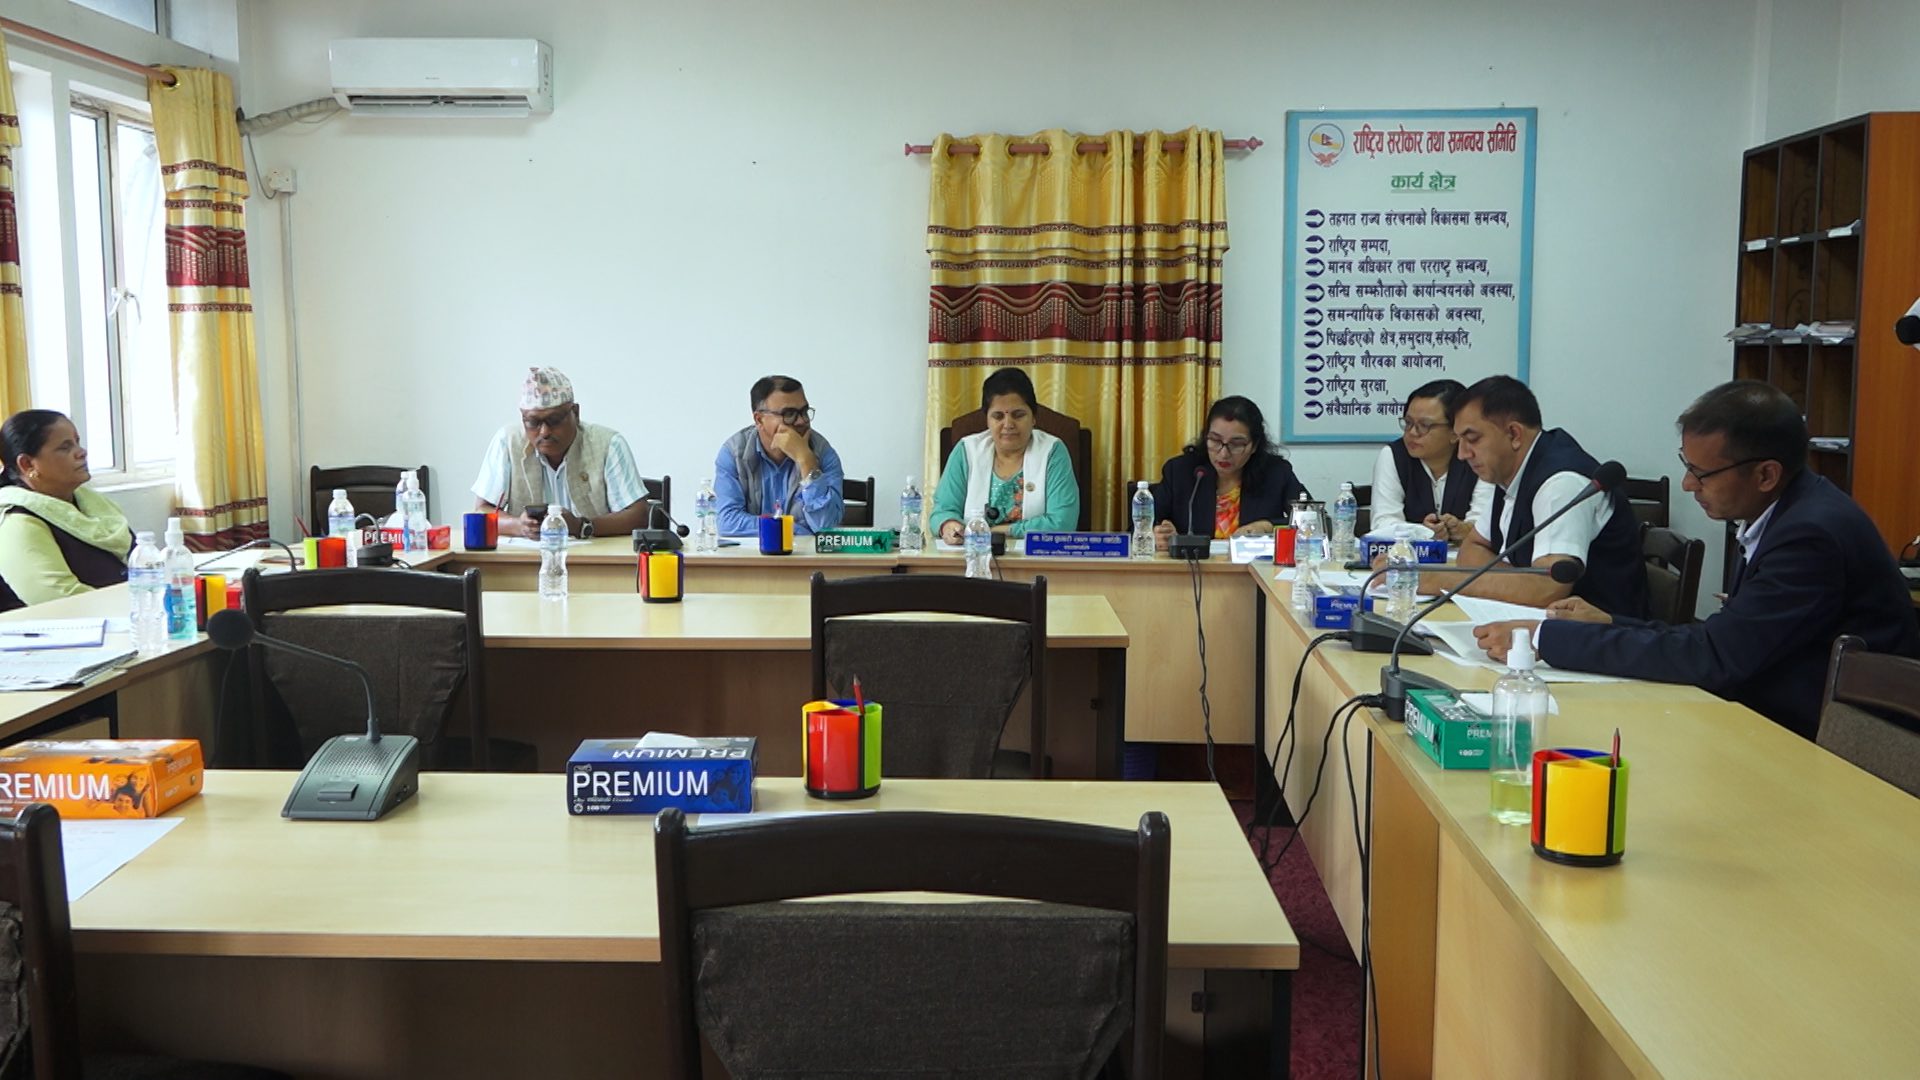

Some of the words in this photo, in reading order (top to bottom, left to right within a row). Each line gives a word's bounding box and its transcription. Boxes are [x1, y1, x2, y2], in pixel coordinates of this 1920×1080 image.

[1353, 123, 1384, 158] राष्ट्रिय
[1387, 124, 1424, 154] सरोकार
[1426, 130, 1445, 153] तथा
[1448, 130, 1484, 153] समन्वय
[1487, 121, 1518, 153] समिति
[1391, 171, 1424, 189] कार्य
[1428, 170, 1457, 190] क्षेत्र
[1329, 213, 1356, 226] तहगत
[1431, 208, 1470, 225] विकासमा
[1357, 256, 1393, 273] अधिकार
[1390, 304, 1440, 322] विकासको
[817, 535, 873, 547] PREMIUM
[0, 772, 111, 800] REMIUM
[573, 770, 709, 797] PREMIUM
